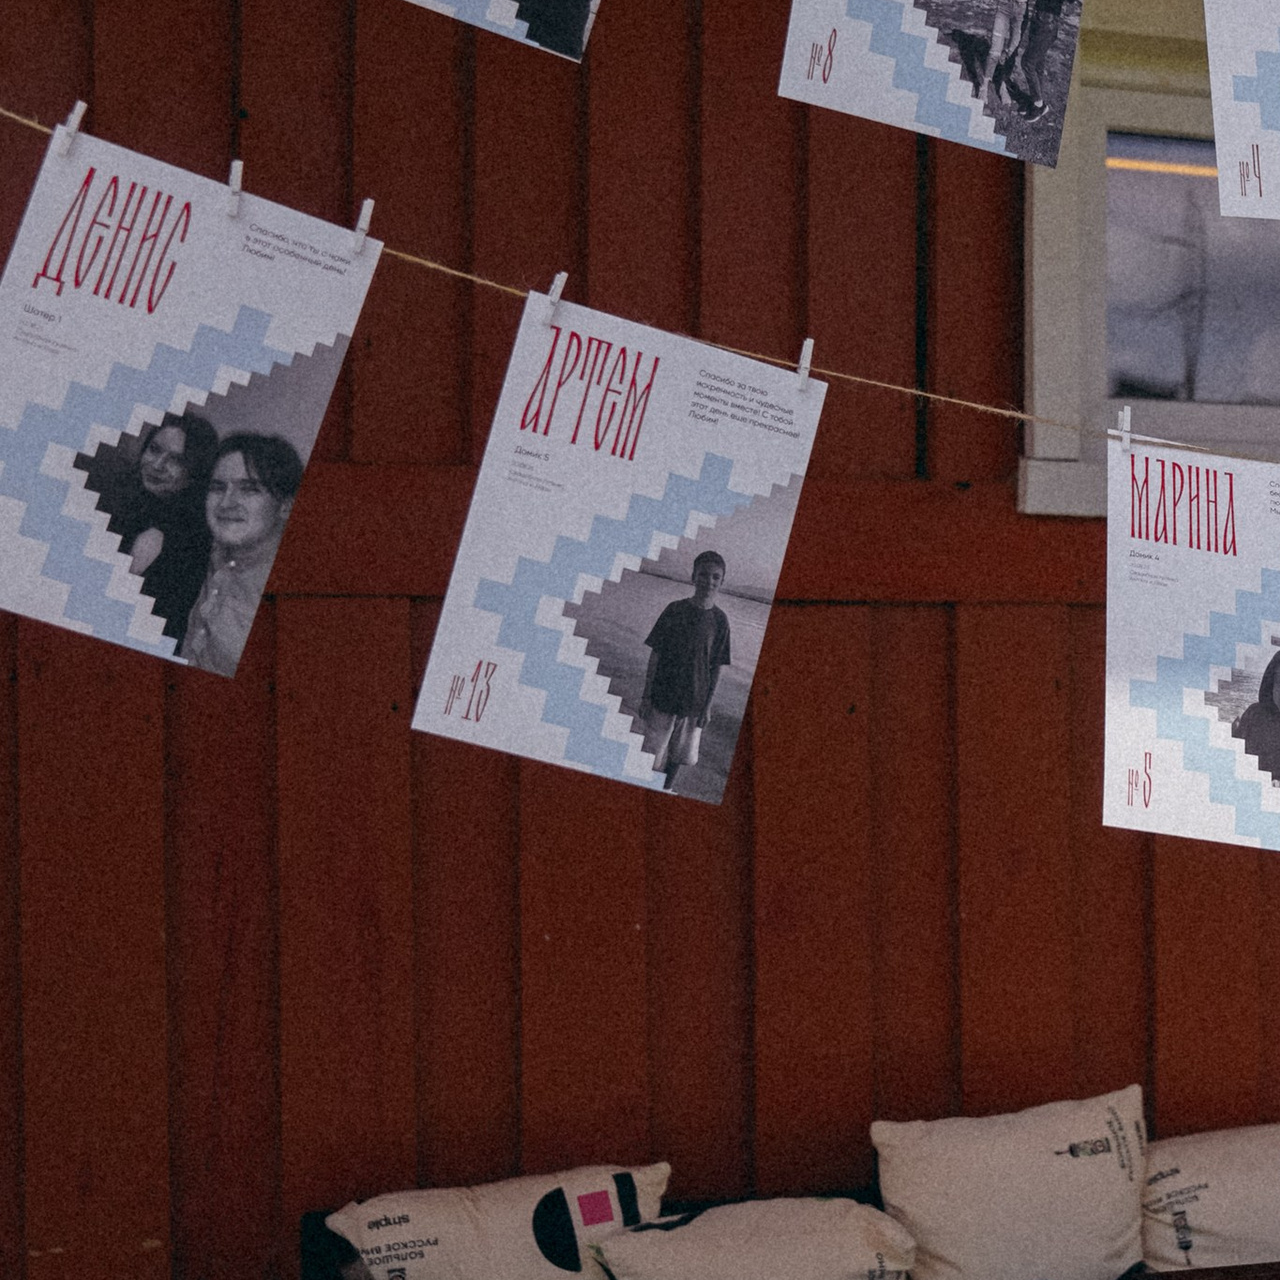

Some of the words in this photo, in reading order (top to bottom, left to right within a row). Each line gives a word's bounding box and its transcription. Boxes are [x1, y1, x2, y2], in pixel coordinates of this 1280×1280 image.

[32, 166, 192, 314] ДЕНИС
[248, 222, 291, 244] Спасибо,
[291, 240, 307, 250] что
[308, 246, 319, 254] ты
[328, 253, 351, 265] нами
[252, 238, 271, 248] этот
[272, 245, 322, 266] особенный
[321, 262, 346, 276] день!
[22, 304, 56, 323] Шатер
[519, 324, 660, 461] АРТЕМ
[698, 369, 735, 386] Спасибо
[736, 382, 746, 390] за
[747, 386, 768, 396] твою
[691, 401, 708, 411] этот
[709, 407, 729, 418] день
[693, 391, 728, 406] моменты
[730, 401, 760, 415] вместе!
[761, 410, 769, 418] С
[769, 413, 793, 426] тобой
[696, 381, 747, 401] искренность
[755, 399, 794, 415] чудесные
[514, 444, 542, 460] Домик
[1130, 453, 1238, 557] МАРИНА
[1269, 506, 1280, 515] Мы
[1129, 549, 1153, 560] Домик
[367, 1250, 425, 1266] БОЛЬШОЕ
[386, 1238, 439, 1254] РУССКОЕ
